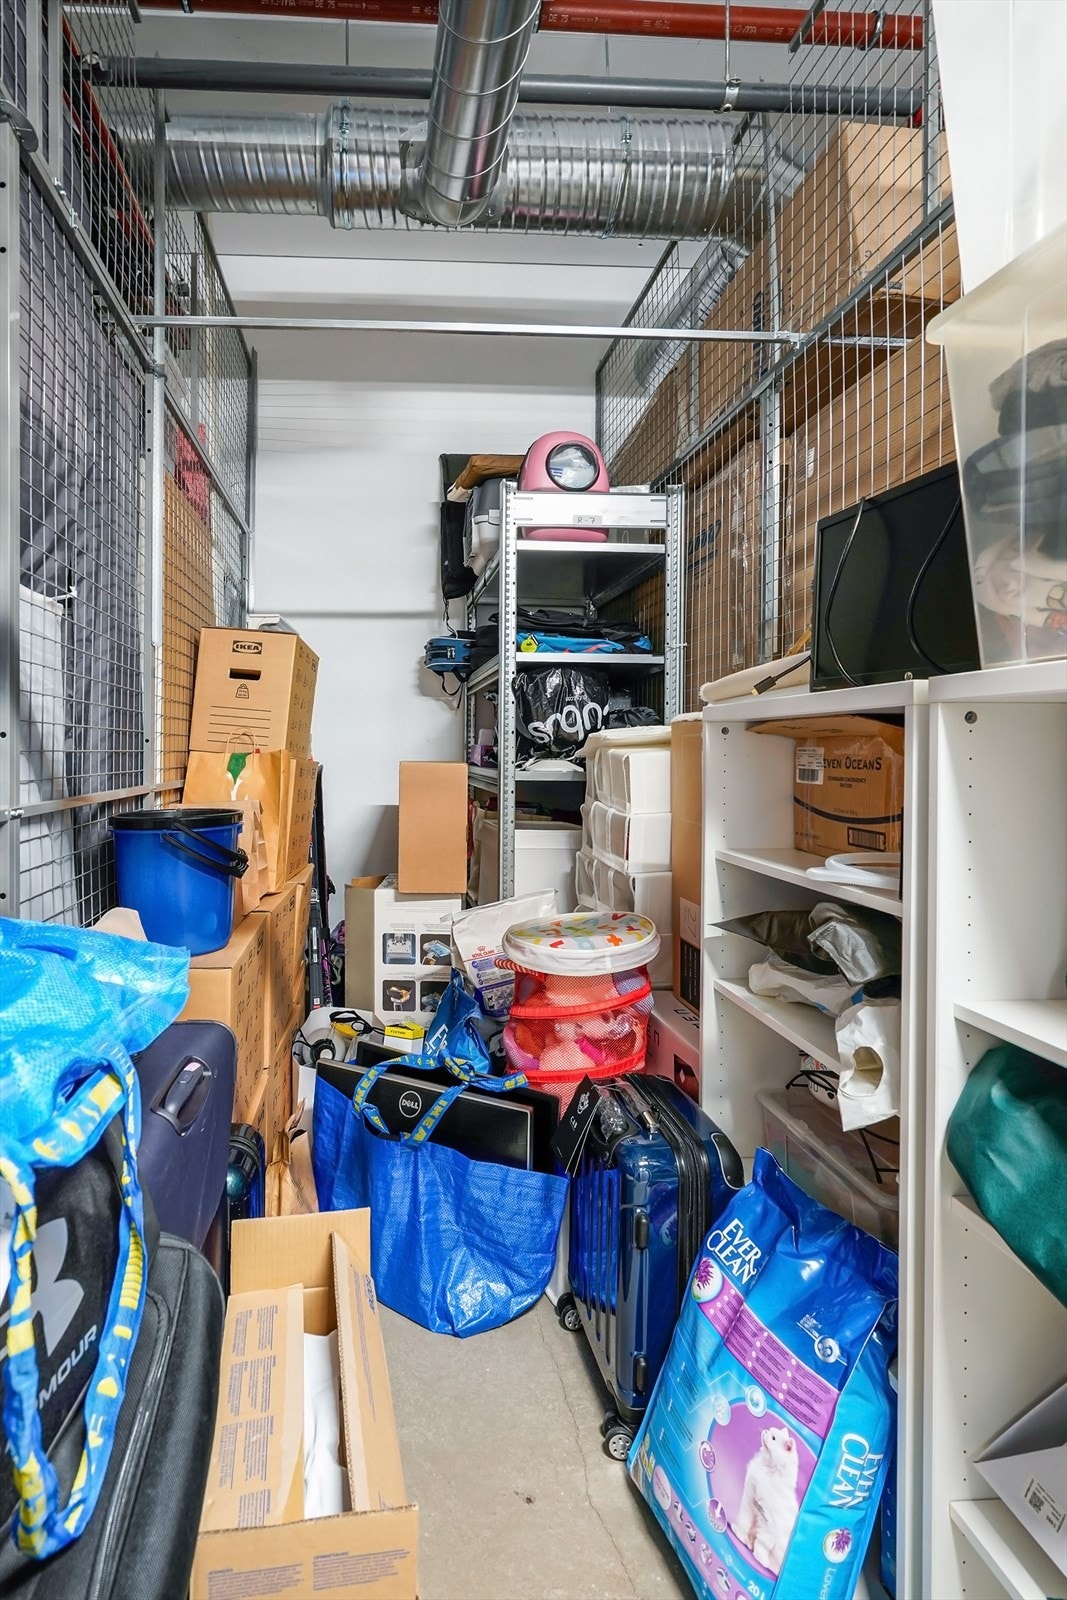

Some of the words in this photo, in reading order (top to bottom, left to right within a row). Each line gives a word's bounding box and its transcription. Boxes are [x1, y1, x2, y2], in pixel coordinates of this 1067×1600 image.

[315, 0, 324, 8] DE
[327, 0, 336, 9] 75
[548, 14, 558, 22] DE
[560, 14, 569, 23] 75
[577, 516, 595, 524] R-7
[234, 642, 260, 652] IKEA
[823, 757, 841, 769] EVEN
[401, 1100, 419, 1110] DELL
[413, 1099, 448, 1143] IKEA
[722, 1218, 761, 1275] EVER
[706, 1229, 756, 1285] CLEAN
[38, 1324, 98, 1411] MOUR
[828, 1433, 870, 1508] CLEAN
[747, 1580, 760, 1598] 20
